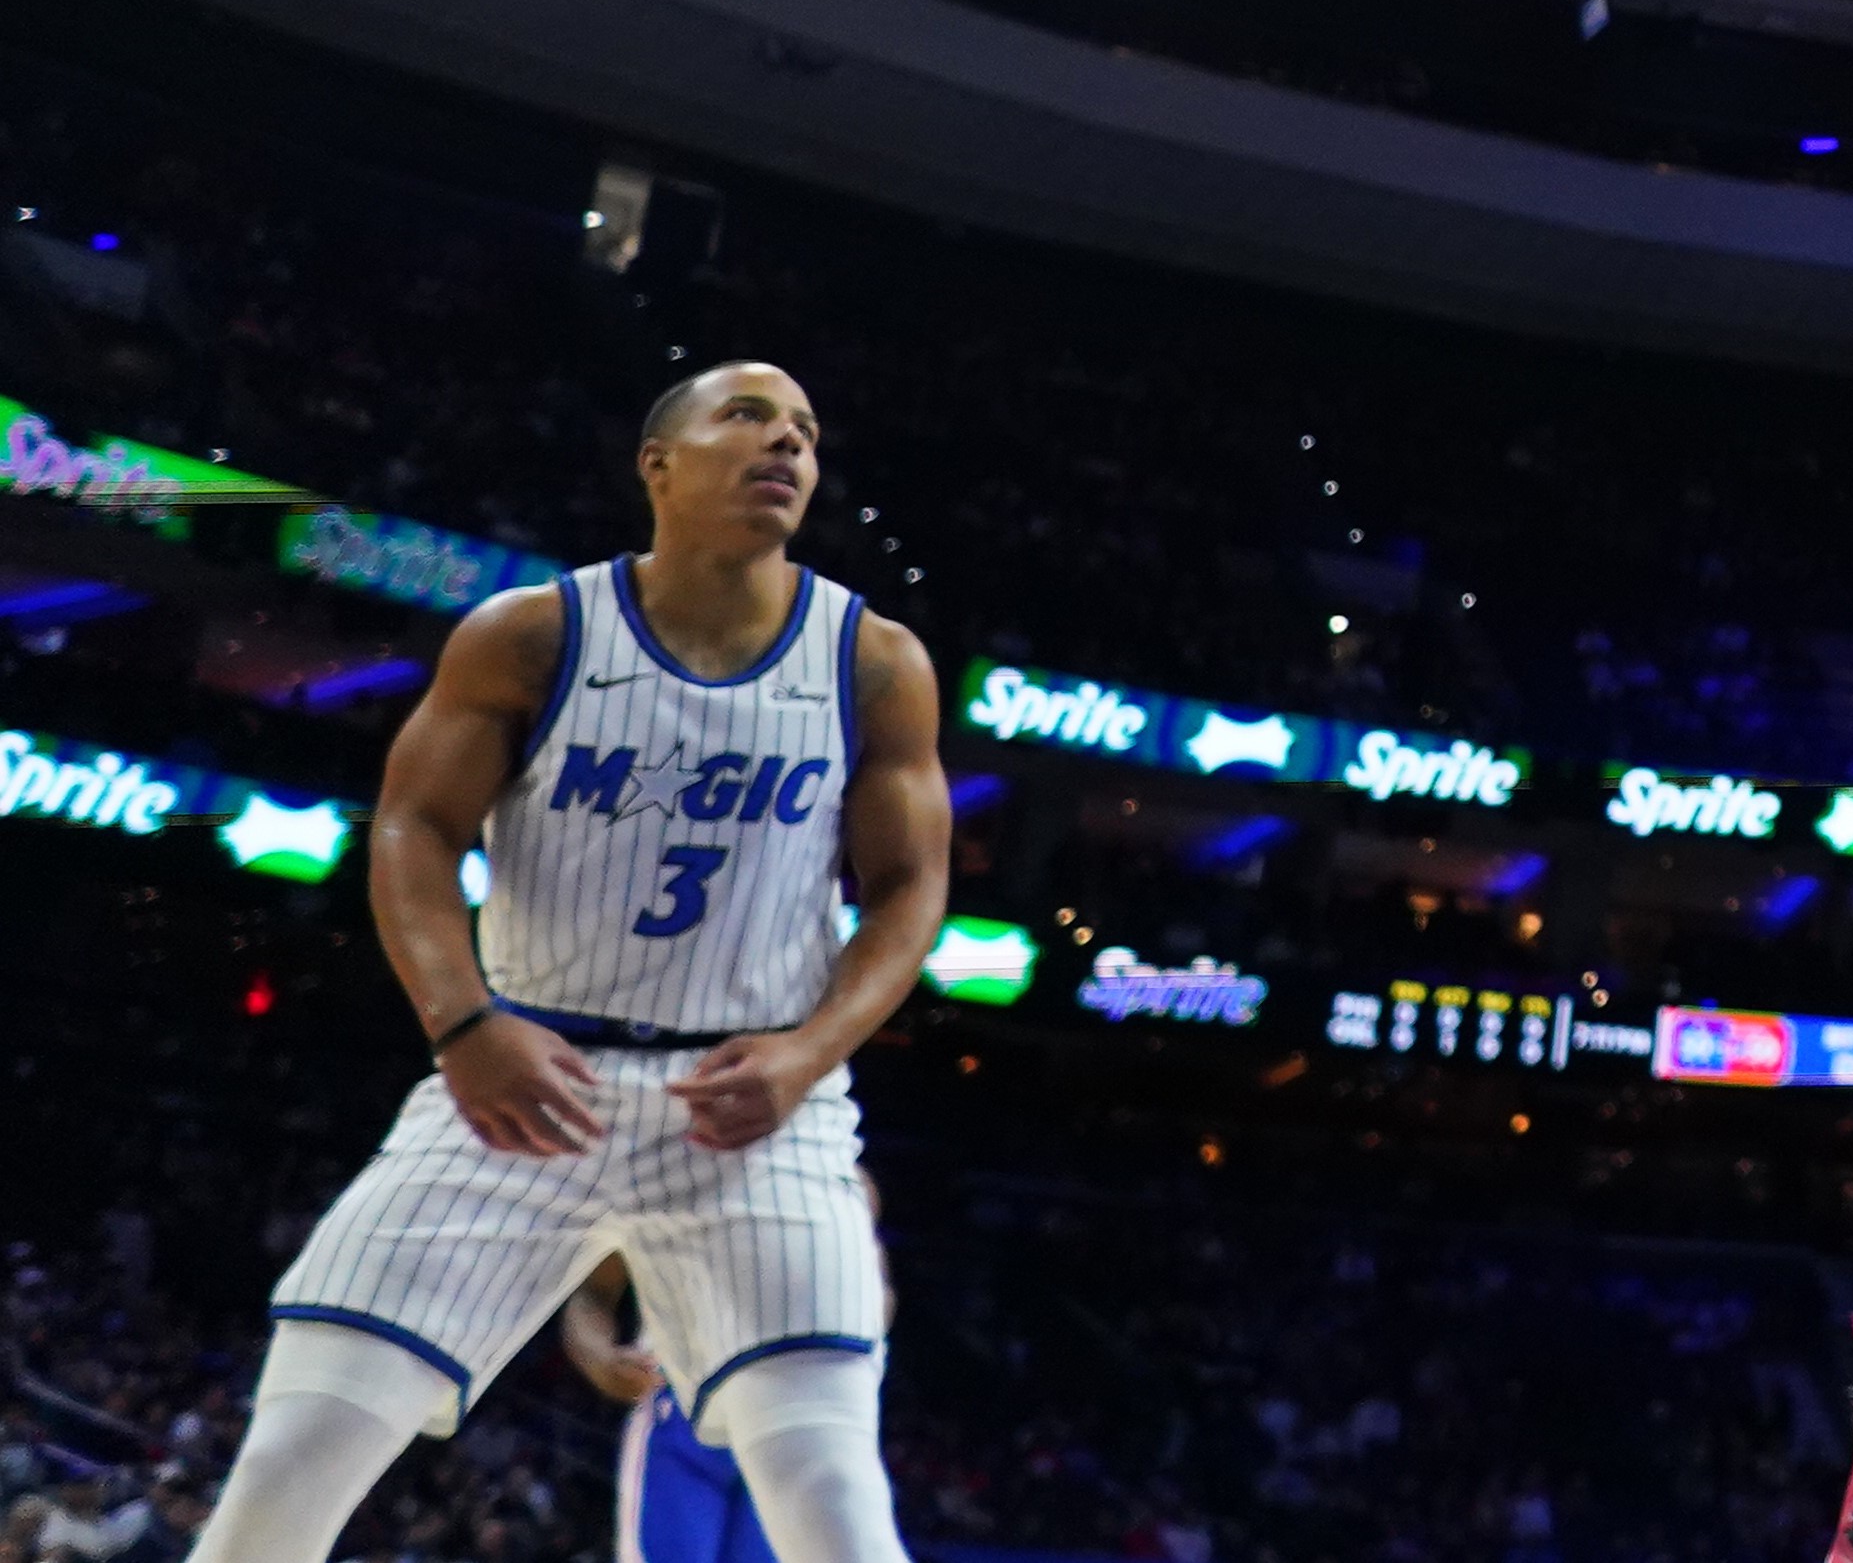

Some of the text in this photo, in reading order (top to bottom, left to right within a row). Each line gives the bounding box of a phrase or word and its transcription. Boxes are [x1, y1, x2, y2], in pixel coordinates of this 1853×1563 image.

[968, 666, 1148, 752] Sprite
[1344, 730, 1521, 806] Sprite
[1607, 766, 1783, 836] Sprite
[633, 844, 728, 937] 3
